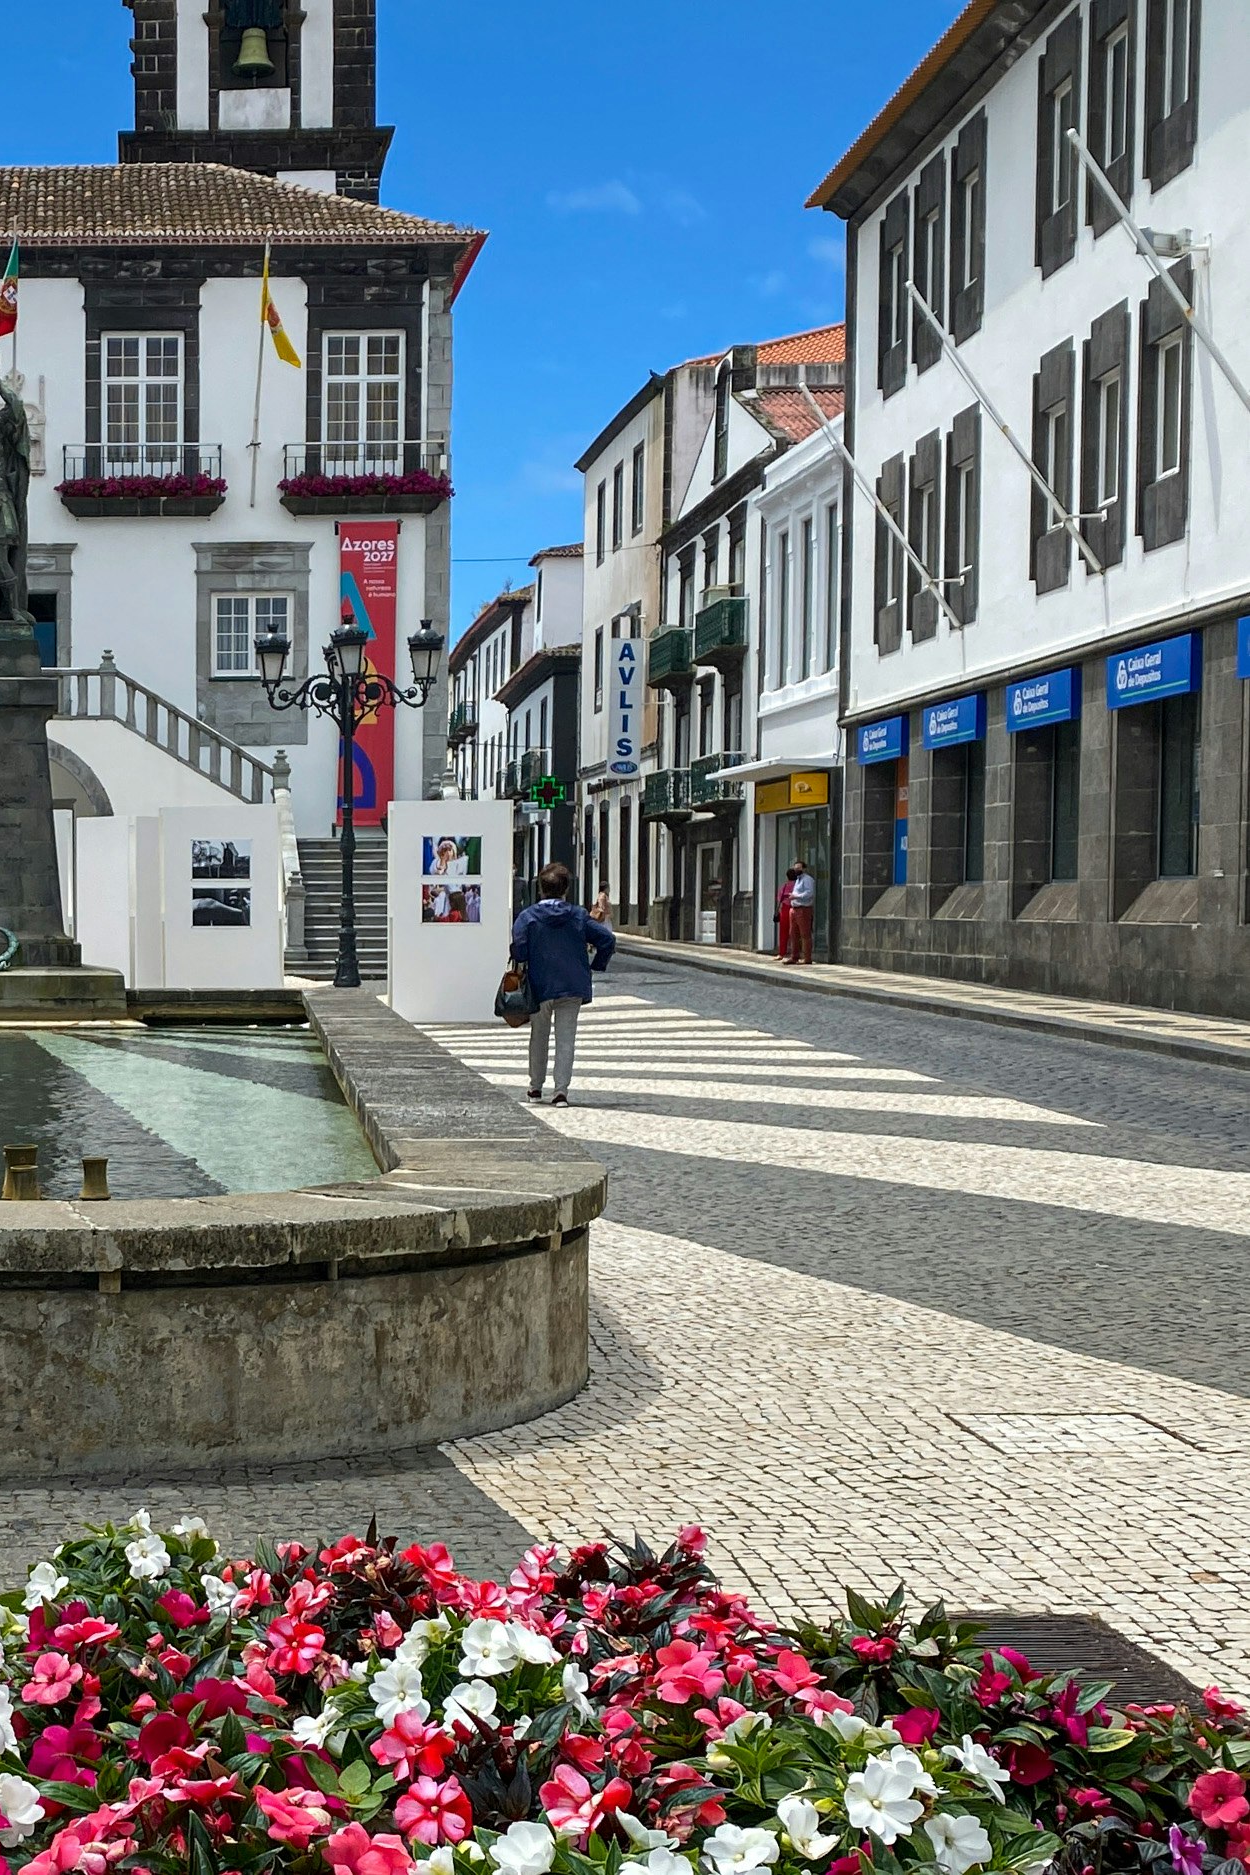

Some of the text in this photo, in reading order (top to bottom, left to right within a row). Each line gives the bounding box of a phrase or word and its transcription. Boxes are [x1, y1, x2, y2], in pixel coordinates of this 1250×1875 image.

[341, 536, 395, 551] Azores
[363, 551, 395, 562] 2027
[1128, 649, 1161, 671] Caixa Geral
[616, 643, 635, 756] AVLIS
[1022, 681, 1049, 700] Caixa Geral
